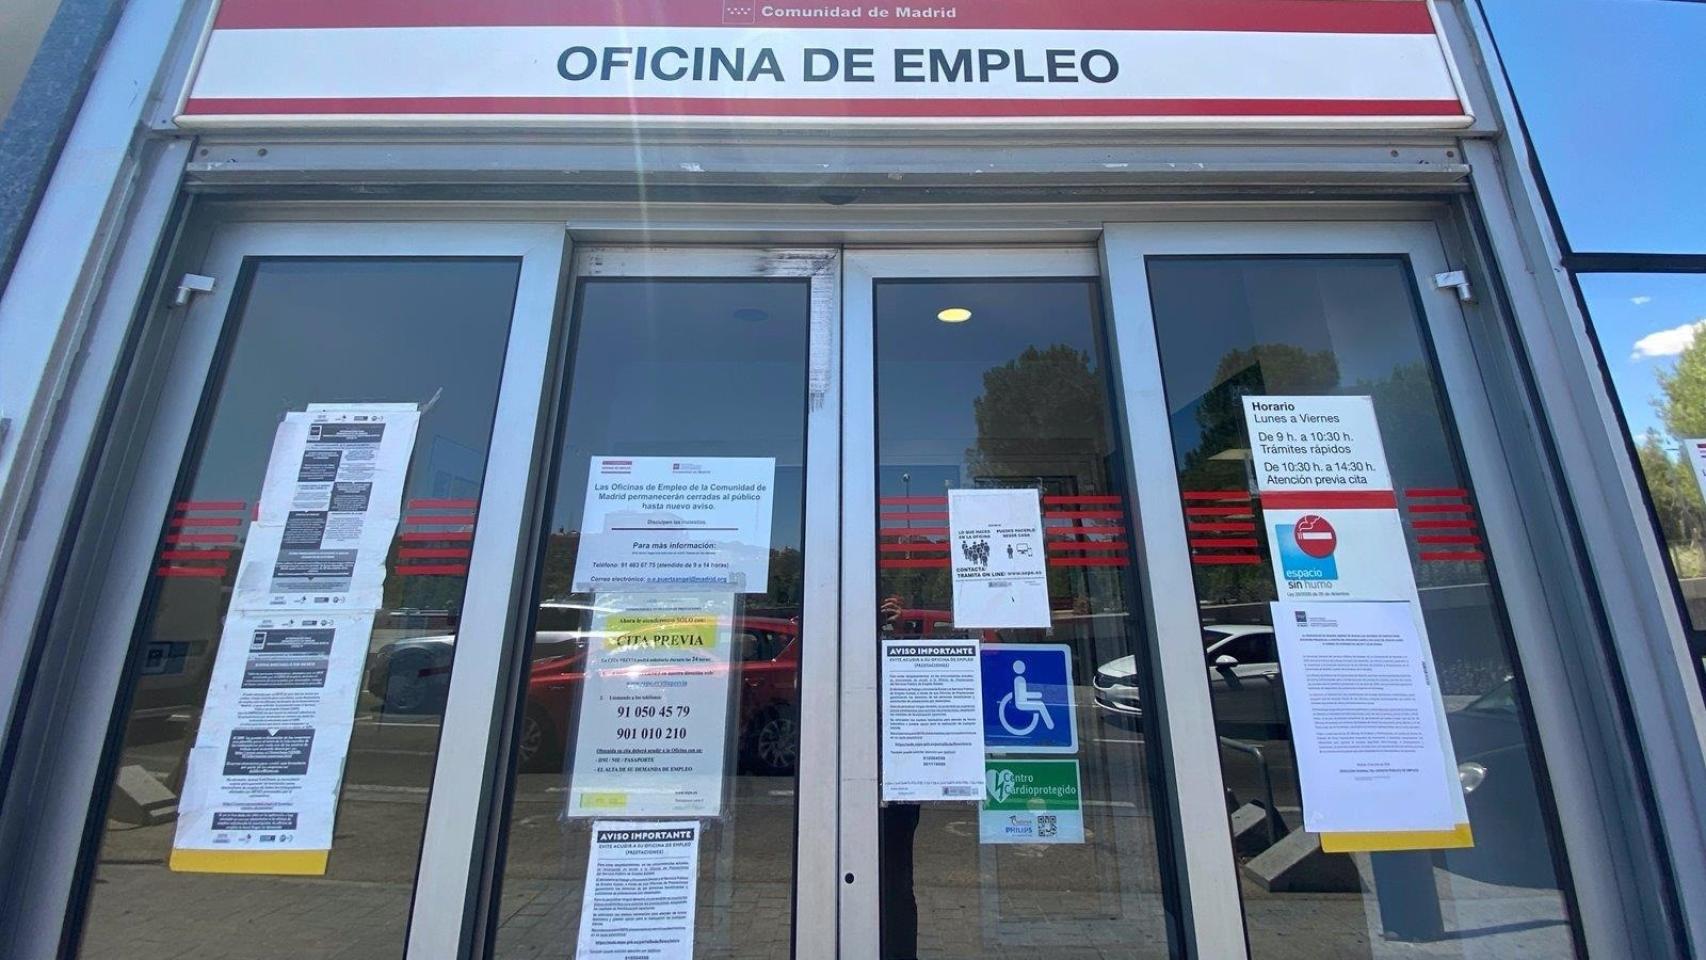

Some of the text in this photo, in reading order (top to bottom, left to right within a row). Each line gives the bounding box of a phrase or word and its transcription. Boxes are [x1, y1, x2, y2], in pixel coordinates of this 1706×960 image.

[761, 6, 957, 18] Comunidad de Madrid
[555, 45, 1121, 84] OFICINA DE EMPLEO
[1251, 402, 1295, 412] Horario
[1254, 414, 1287, 423] Lunes
[1299, 414, 1340, 423] Viernes
[1258, 432, 1354, 442] De 9 h. a 10:30 h.
[1261, 444, 1351, 456] Trámites rápidos
[1264, 462, 1376, 472] De 10:30 h. a 14:30 h.
[1267, 474, 1368, 486] Atención previa cita
[594, 484, 609, 492] Las
[612, 483, 644, 491] Oficinas
[658, 484, 687, 493] Empleo
[690, 484, 700, 492] de
[701, 484, 709, 492] la
[710, 484, 755, 492] Comunidad
[757, 484, 767, 492] de
[598, 493, 626, 501] Madrid
[628, 494, 685, 502] permanecerán
[723, 493, 730, 501] al
[731, 494, 761, 502] público
[642, 502, 664, 510] hasta
[632, 541, 650, 549] Para
[669, 541, 717, 549] información:
[1286, 568, 1323, 579] espacio
[1288, 580, 1333, 589] sin humo
[617, 634, 704, 647] CITA PREVIA
[889, 647, 973, 655] AVISO IMPORTANTE
[617, 706, 690, 718] 91 050 45 79
[617, 728, 687, 740] 901 010 210
[1003, 772, 1034, 783] Centro
[1004, 784, 1077, 797] Cardioprotegido
[599, 830, 692, 841] AVISO IMPORTANTE
